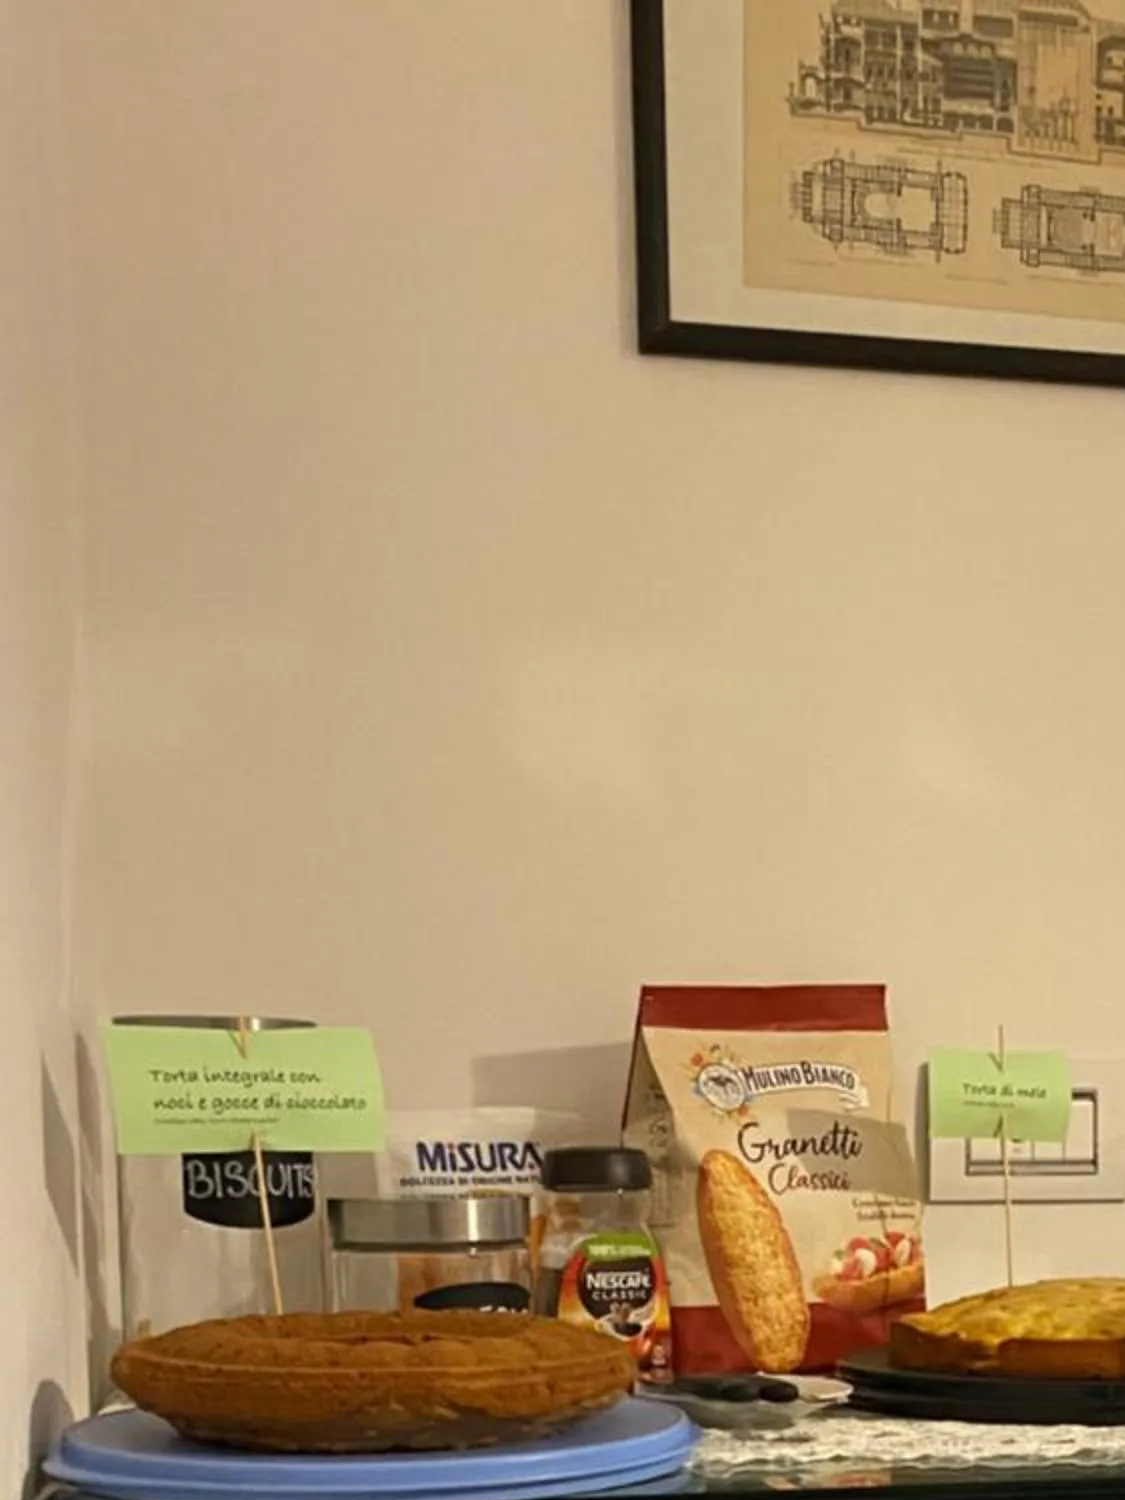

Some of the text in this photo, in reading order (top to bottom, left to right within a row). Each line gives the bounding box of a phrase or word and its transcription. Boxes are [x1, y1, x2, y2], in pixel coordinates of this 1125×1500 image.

[149, 1065, 321, 1088] Torta integrale con
[153, 1091, 367, 1115] noci e gocce di cioccolato
[737, 1119, 863, 1164] Granetti
[768, 1163, 851, 1195] Classici
